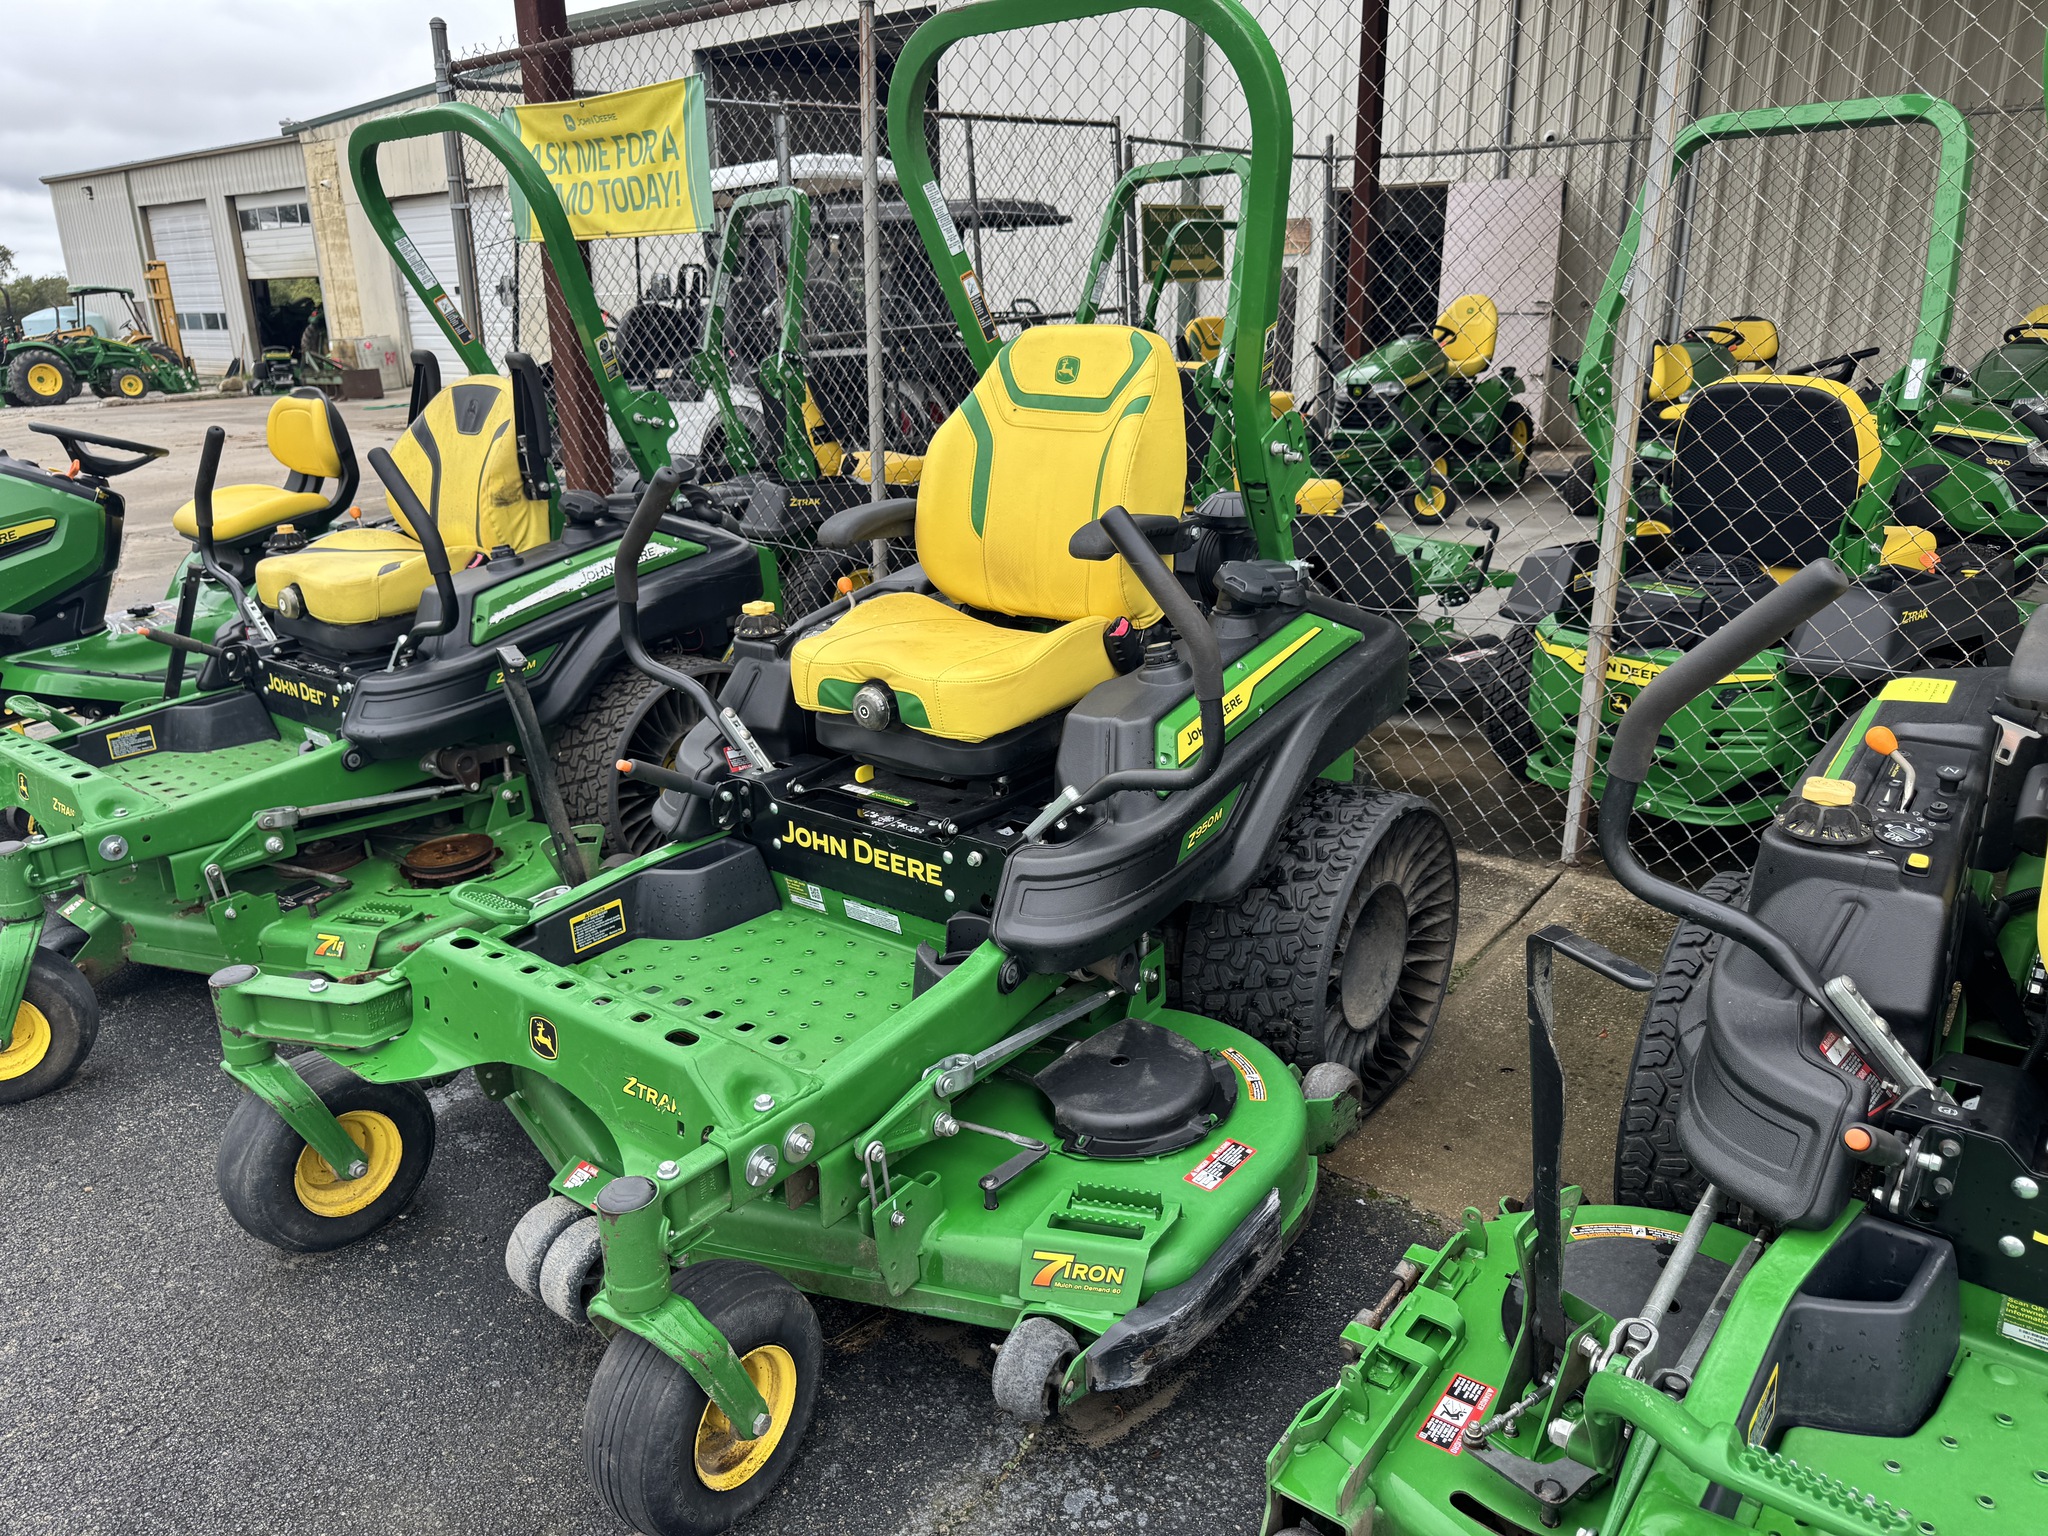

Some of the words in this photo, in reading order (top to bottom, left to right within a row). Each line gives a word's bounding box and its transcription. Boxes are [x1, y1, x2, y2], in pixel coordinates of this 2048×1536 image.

[577, 115, 594, 127] JOHN
[594, 113, 618, 123] DEERE
[531, 143, 572, 175] ASK
[572, 137, 610, 174] ME
[611, 129, 658, 170] FOR
[662, 124, 680, 162] A
[551, 182, 594, 216] MO
[598, 169, 681, 214] TODAY!
[790, 497, 821, 507] ZTRAK
[580, 564, 614, 585] JOHN
[1901, 607, 1929, 624] ZTRAK
[268, 672, 299, 698] JOHN
[1187, 807, 1223, 850] Z950M
[782, 820, 848, 859] JOHN
[853, 837, 943, 887] DEERE
[1054, 1281, 1073, 1289] Mulch
[1083, 1285, 1111, 1293] Demand
[1112, 1287, 1122, 1295] 60
[2007, 1302, 2018, 1311] for
[2020, 1306, 2048, 1319] owner
[2008, 1296, 2029, 1309] Scan
[2030, 1303, 2045, 1313] QR
